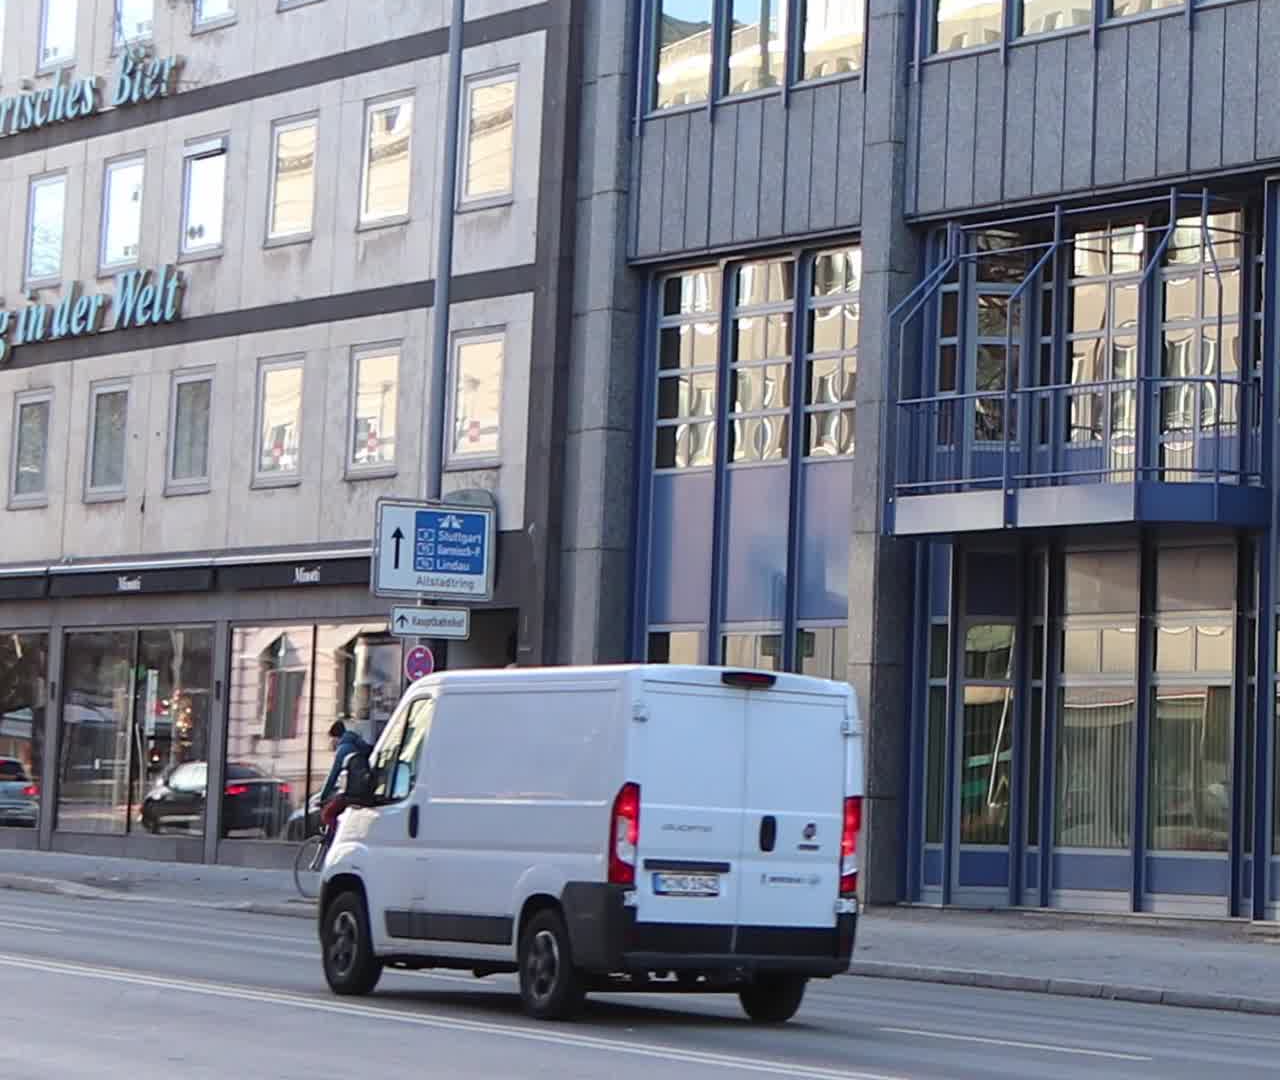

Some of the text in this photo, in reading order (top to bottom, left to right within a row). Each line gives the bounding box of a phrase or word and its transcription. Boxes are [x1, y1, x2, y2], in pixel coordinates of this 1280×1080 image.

[112, 48, 178, 106] Bier
[16, 288, 47, 344] in
[52, 279, 103, 339] der
[112, 263, 179, 329] Welt
[438, 530, 482, 545] Stuttgart
[436, 559, 470, 572] Lindau
